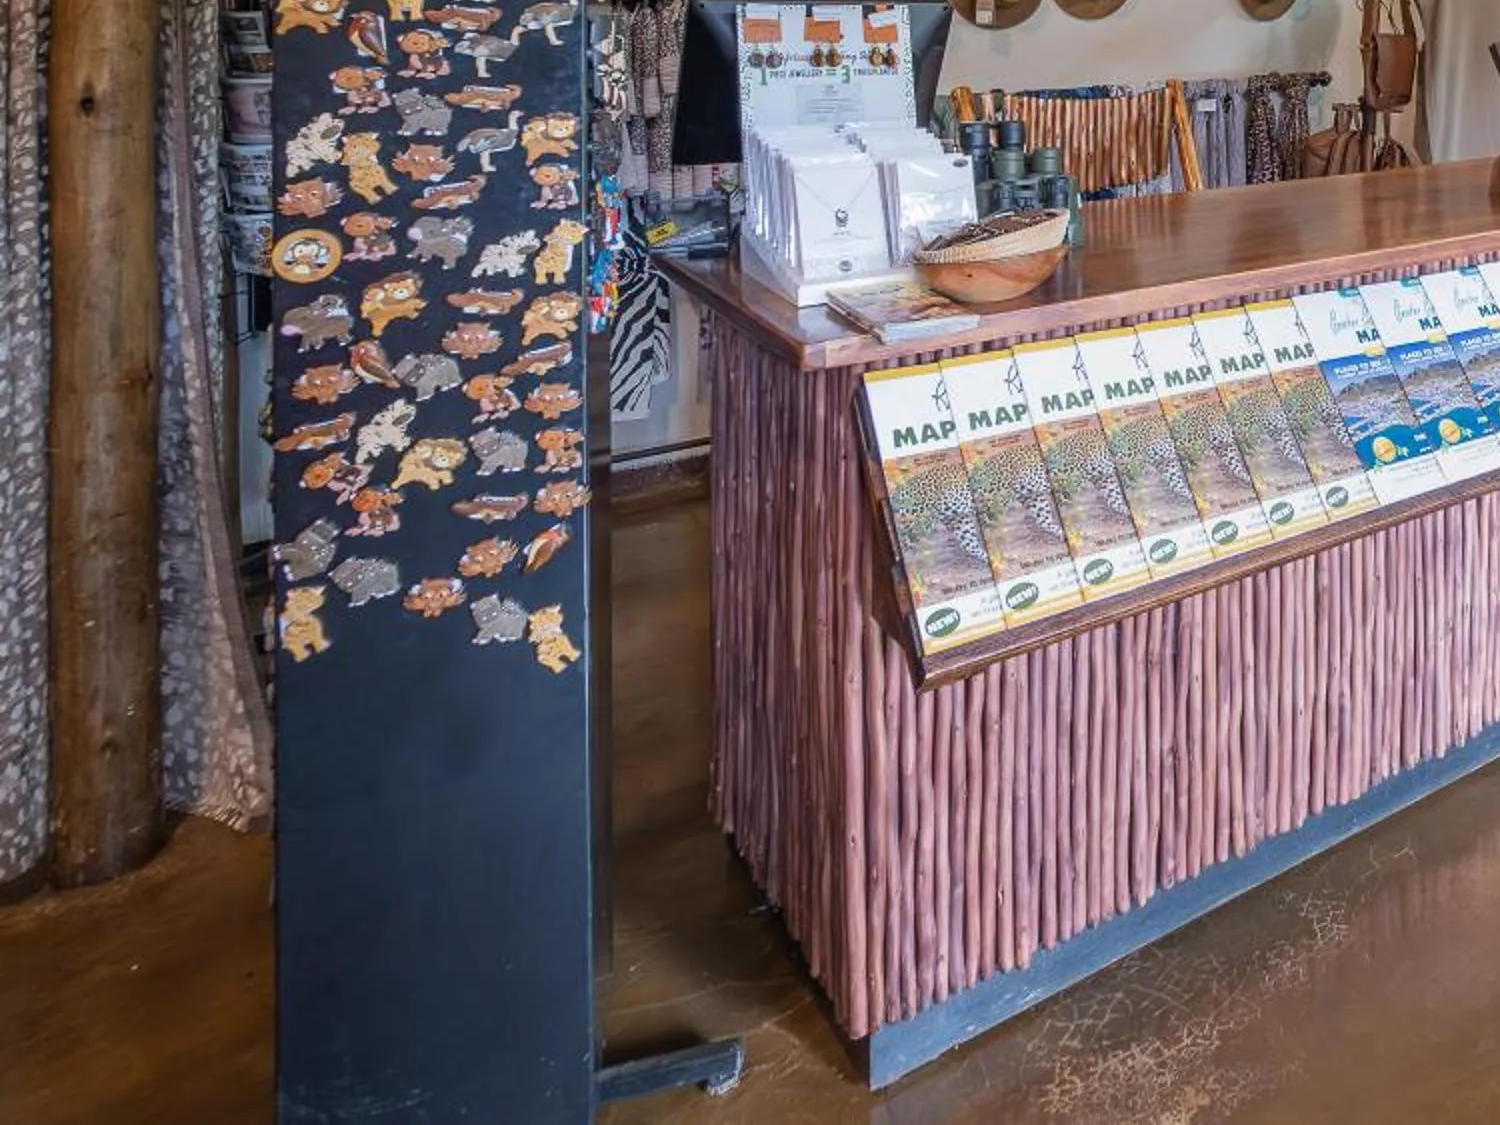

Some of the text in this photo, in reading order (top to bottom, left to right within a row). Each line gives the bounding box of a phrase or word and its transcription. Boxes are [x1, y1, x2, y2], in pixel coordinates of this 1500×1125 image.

[1478, 303, 1500, 318] MA
[1418, 316, 1443, 331] MA
[1355, 328, 1381, 344] MA
[1220, 352, 1266, 375] MAP
[1273, 341, 1316, 364] MAP
[1164, 364, 1212, 388] MAP
[1104, 377, 1155, 401] MAP
[1040, 388, 1095, 415] MAP
[968, 403, 1028, 431] MAP
[892, 420, 957, 448] MAP
